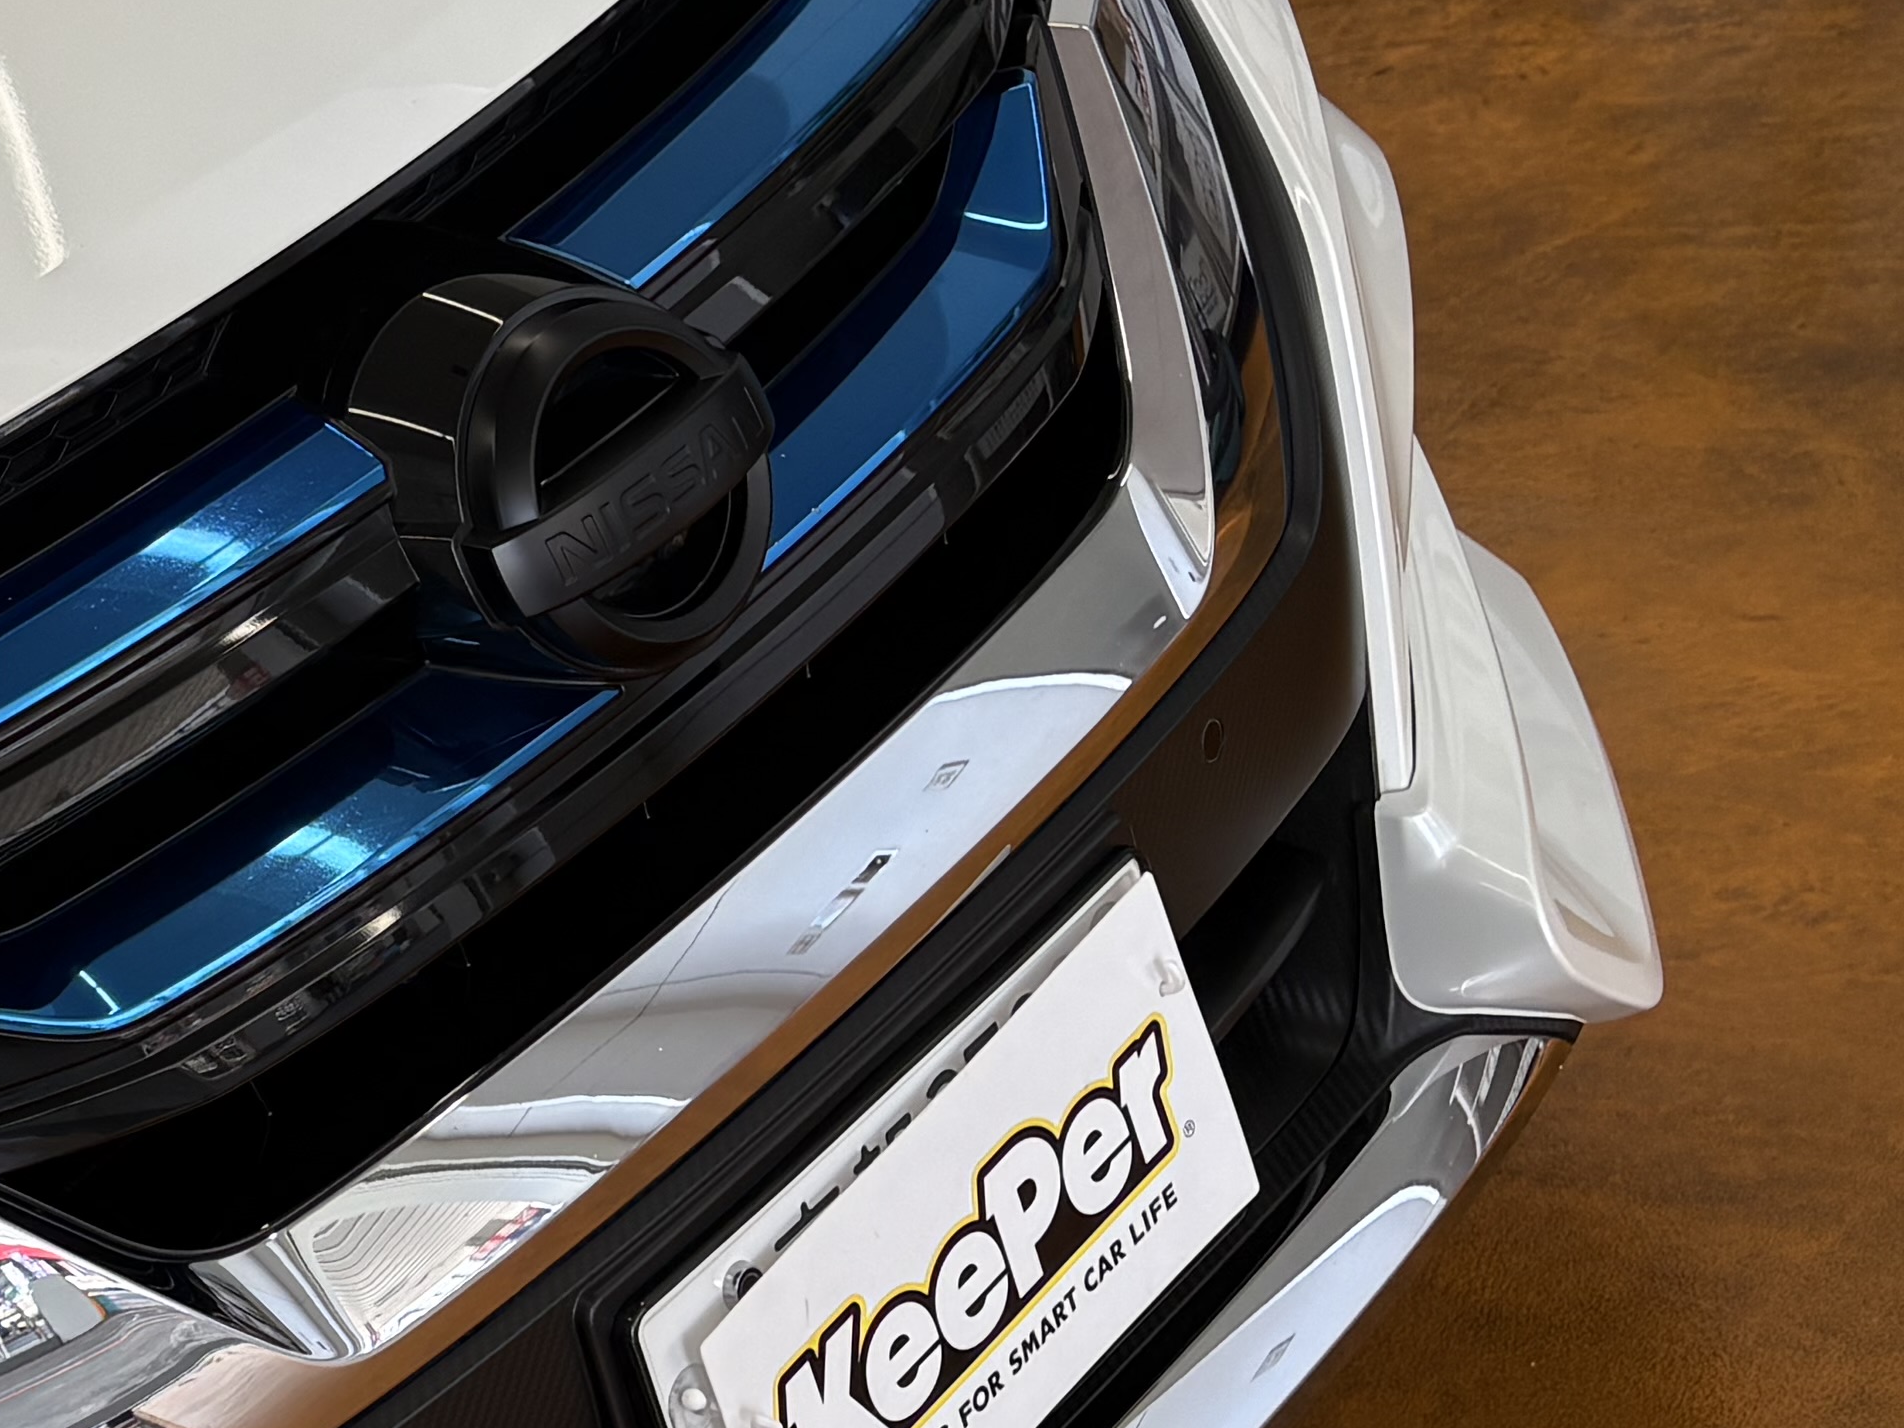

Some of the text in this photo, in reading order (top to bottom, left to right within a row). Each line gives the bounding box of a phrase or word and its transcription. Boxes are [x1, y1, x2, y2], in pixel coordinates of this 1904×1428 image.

[958, 1370, 1005, 1428] FOR
[1008, 1286, 1080, 1376] SMART
[1083, 1239, 1126, 1293] CAR
[1129, 1182, 1179, 1246] LIFE
